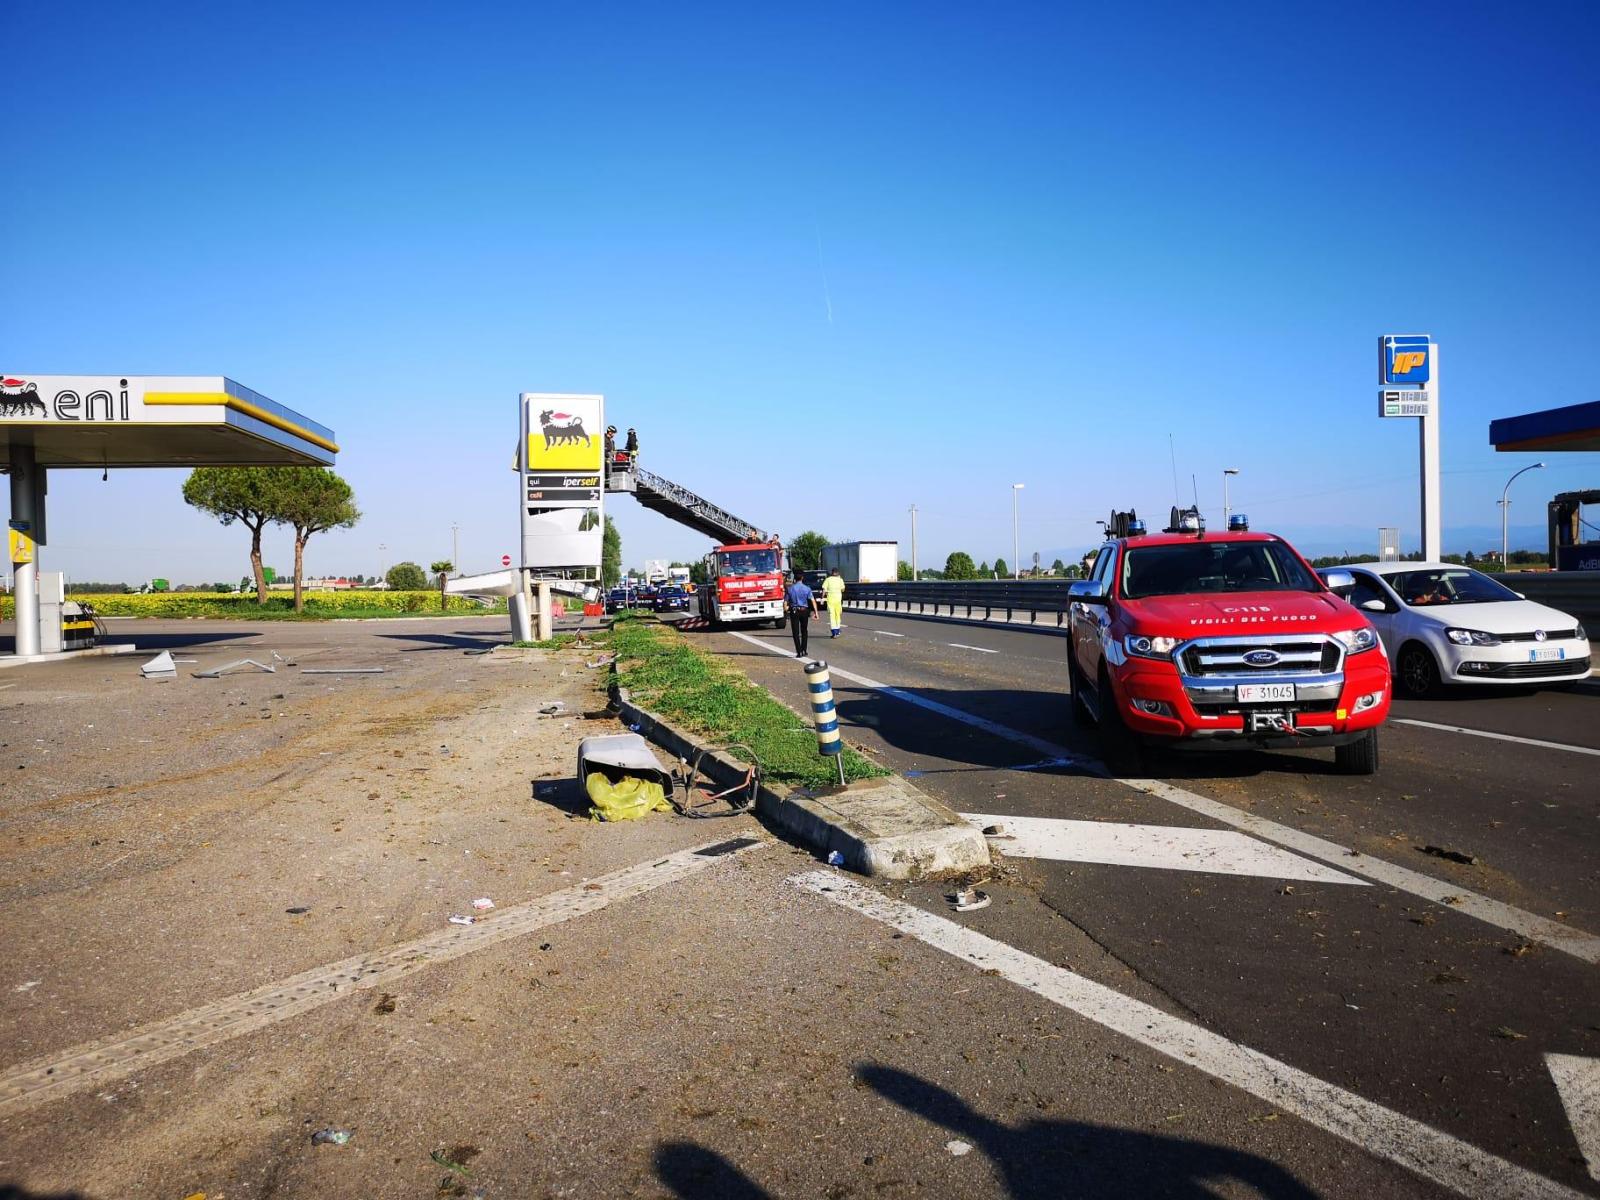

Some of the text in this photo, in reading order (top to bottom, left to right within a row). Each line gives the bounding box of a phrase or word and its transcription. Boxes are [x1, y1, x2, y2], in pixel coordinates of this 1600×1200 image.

[1392, 352, 1426, 374] IP
[53, 378, 129, 421] eni
[529, 476, 598, 488] qui iperself
[1190, 617, 1235, 625] VIGILI
[1272, 614, 1317, 622] FUOCO
[1252, 653, 1272, 662] Ford
[1240, 687, 1292, 699] VF 31045
